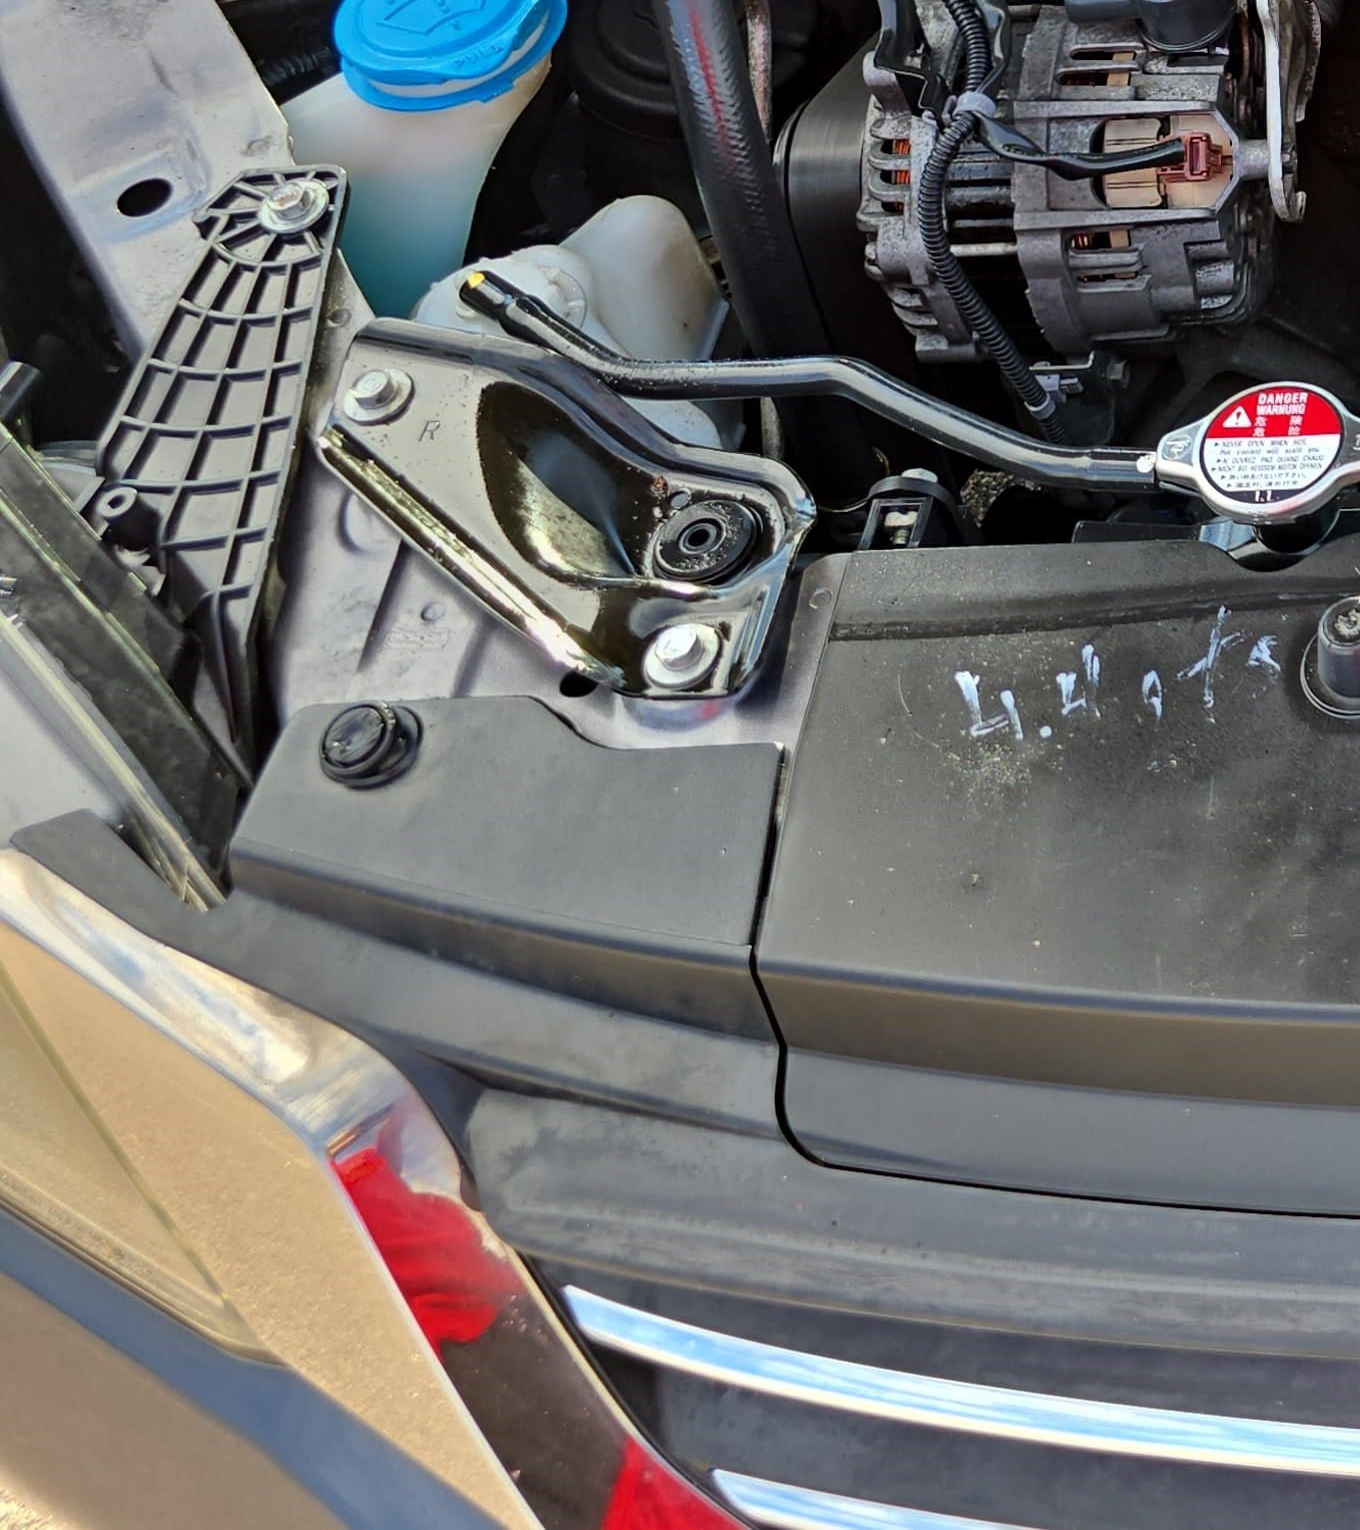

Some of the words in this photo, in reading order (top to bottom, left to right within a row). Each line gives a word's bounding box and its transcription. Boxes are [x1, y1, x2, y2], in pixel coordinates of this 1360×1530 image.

[1258, 391, 1309, 405] DANGER
[1256, 404, 1306, 416] WARNUNG
[418, 420, 441, 442] R
